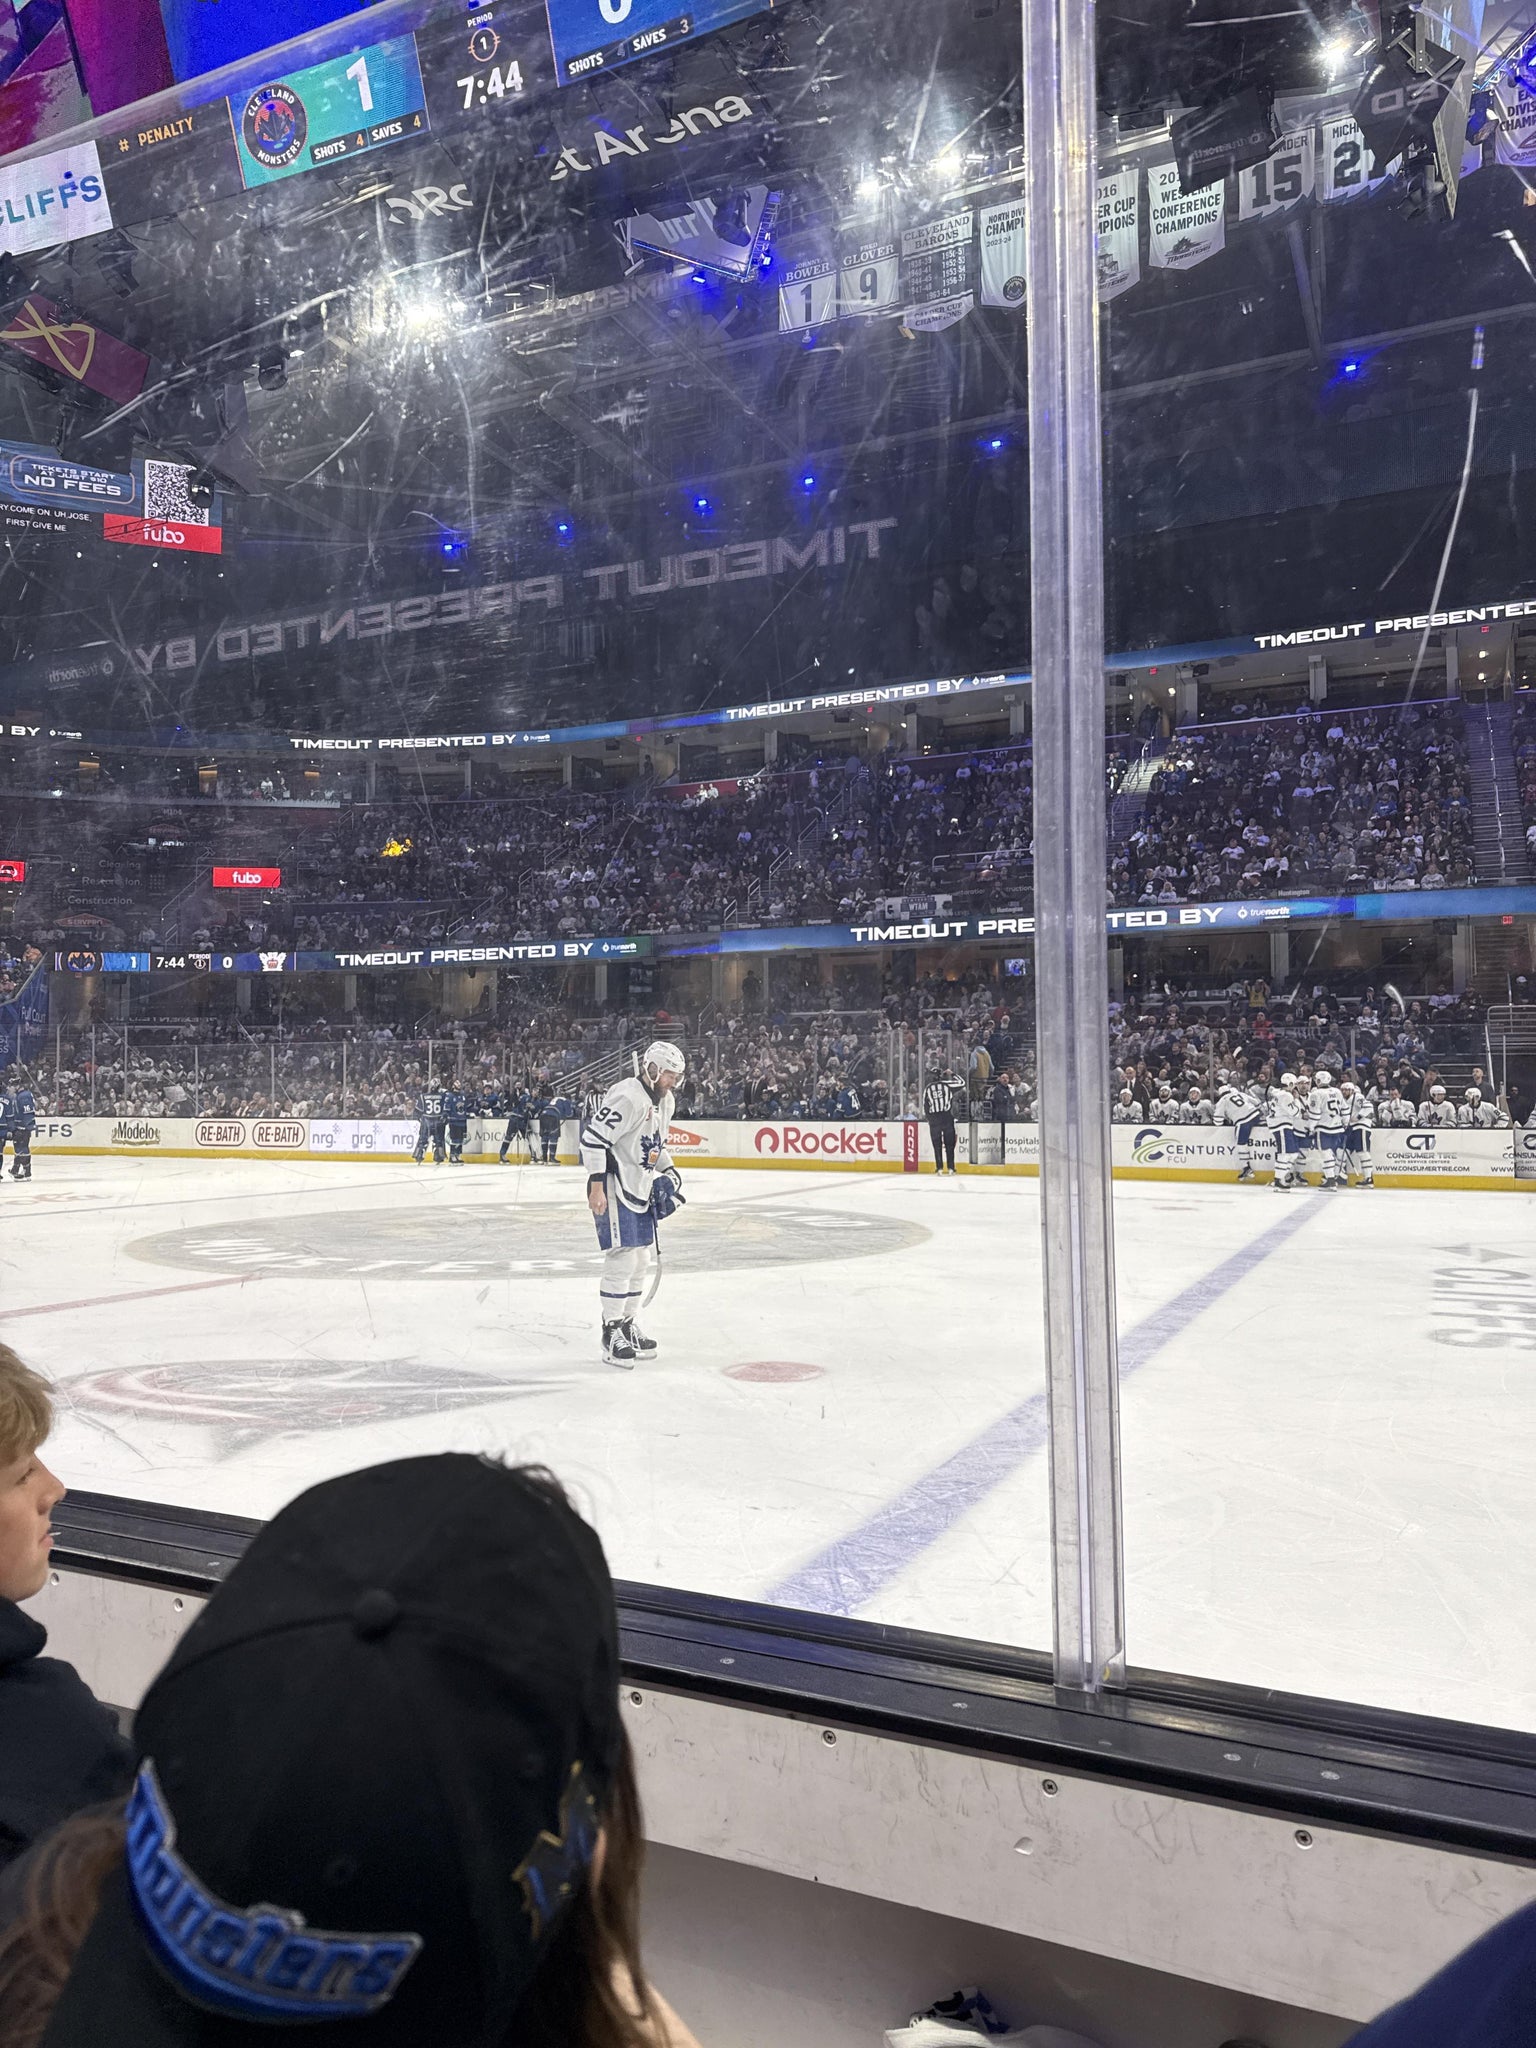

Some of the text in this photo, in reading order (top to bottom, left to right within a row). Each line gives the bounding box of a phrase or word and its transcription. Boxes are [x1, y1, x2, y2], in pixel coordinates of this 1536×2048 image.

[467, 12, 493, 28] PERIOD
[480, 36, 487, 50] 1
[632, 18, 690, 52] SAVES 3
[568, 52, 604, 75] SHOTS
[346, 56, 374, 112] 1
[457, 60, 523, 109] 7:44
[248, 88, 295, 117] CLEVELAND
[138, 117, 194, 148] PENALTY
[371, 114, 422, 142] SAVES 4
[257, 138, 301, 165] MONSTERS
[314, 133, 365, 160] SHOTS 4
[1252, 153, 1302, 209] 15
[988, 210, 1010, 224] NORTH
[1114, 196, 1136, 215] CUP
[1153, 193, 1221, 221] CONFERENCE
[904, 215, 970, 242] CLEVELAND
[1155, 210, 1218, 235] CHAMPIONS
[915, 229, 959, 250] BARONS
[843, 244, 895, 267] GLOVER
[785, 262, 830, 284] BOWER
[859, 268, 878, 301] 9
[800, 283, 813, 323] 1
[946, 301, 963, 312] CUP
[31, 463, 77, 475] TICKETS
[81, 470, 116, 480] START
[24, 474, 121, 497] NO FEES
[10, 505, 35, 515] COME
[6, 517, 67, 532] FIRST GIVE ME
[143, 523, 186, 545] fubo
[1254, 623, 1366, 649] TIMEOUT
[726, 698, 805, 721] TIMEOUT
[811, 683, 931, 710] PRESENTED
[936, 677, 965, 694] BY
[11, 726, 41, 737] BY
[290, 738, 373, 750] TIMEOUT
[378, 735, 486, 749] PRESENTED
[492, 733, 517, 745] BY
[232, 870, 262, 884] fubo
[850, 921, 967, 942] TIMEOUT
[1179, 907, 1223, 925] BY
[130, 956, 233, 969] 1 7:44 0
[335, 950, 424, 966] TIMEOUT
[431, 944, 556, 963] PRESENTED
[564, 942, 593, 957] BY
[425, 1099, 442, 1114] 36
[594, 1106, 623, 1131] 92
[117, 1121, 155, 1140] Modelo
[783, 1126, 887, 1154] Rocket
[906, 1124, 915, 1164] CCM
[1166, 1144, 1236, 1156] CENTURY
[1167, 1156, 1187, 1164] FCU
[1375, 1165, 1471, 1173] WWW.CONSUMERTIRE.COM
